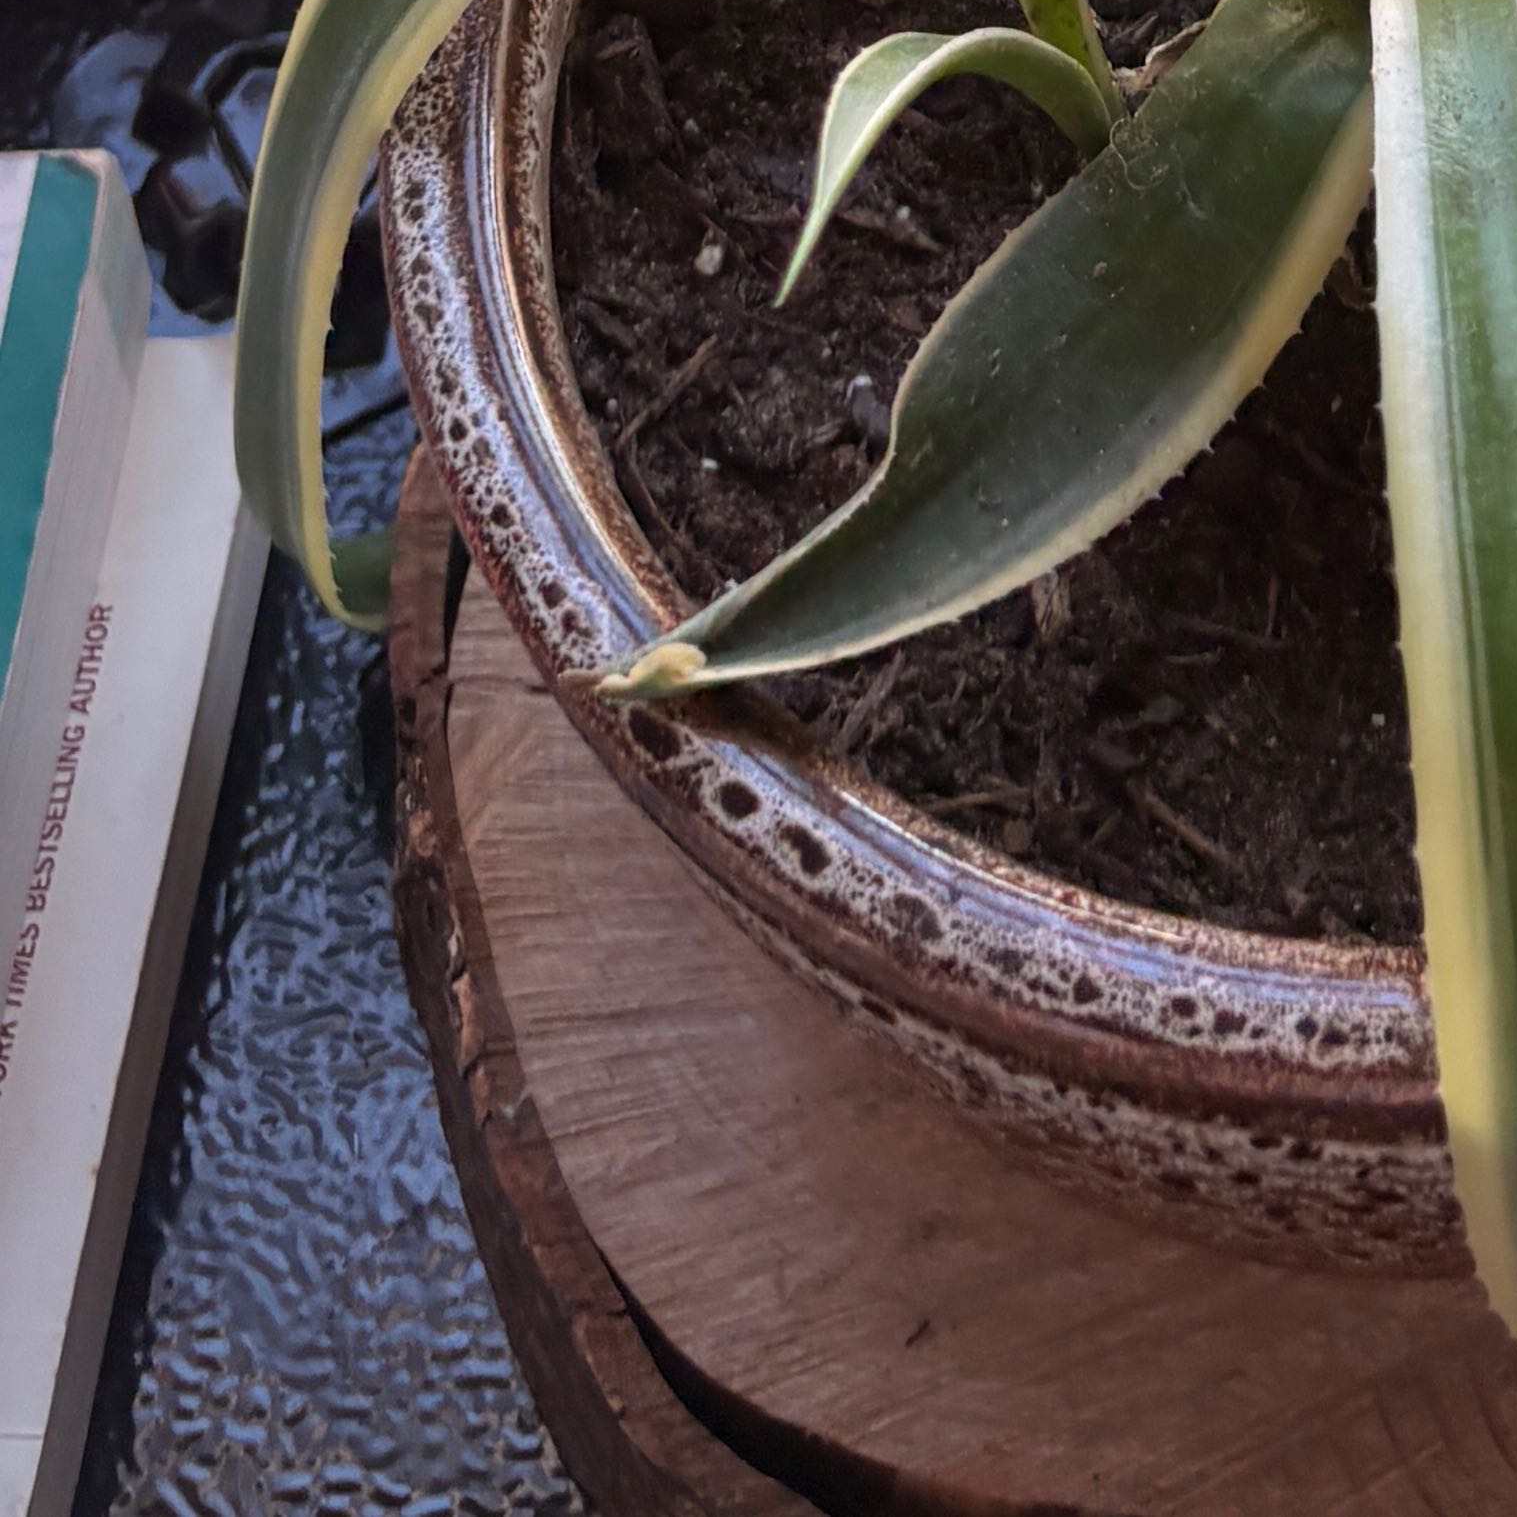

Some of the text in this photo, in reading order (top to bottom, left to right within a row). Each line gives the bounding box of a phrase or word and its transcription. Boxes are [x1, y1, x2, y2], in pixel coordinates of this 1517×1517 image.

[5, 922, 40, 1008] TIMES
[25, 724, 86, 912] BESTSELLING
[69, 602, 114, 716] AUTHOR
